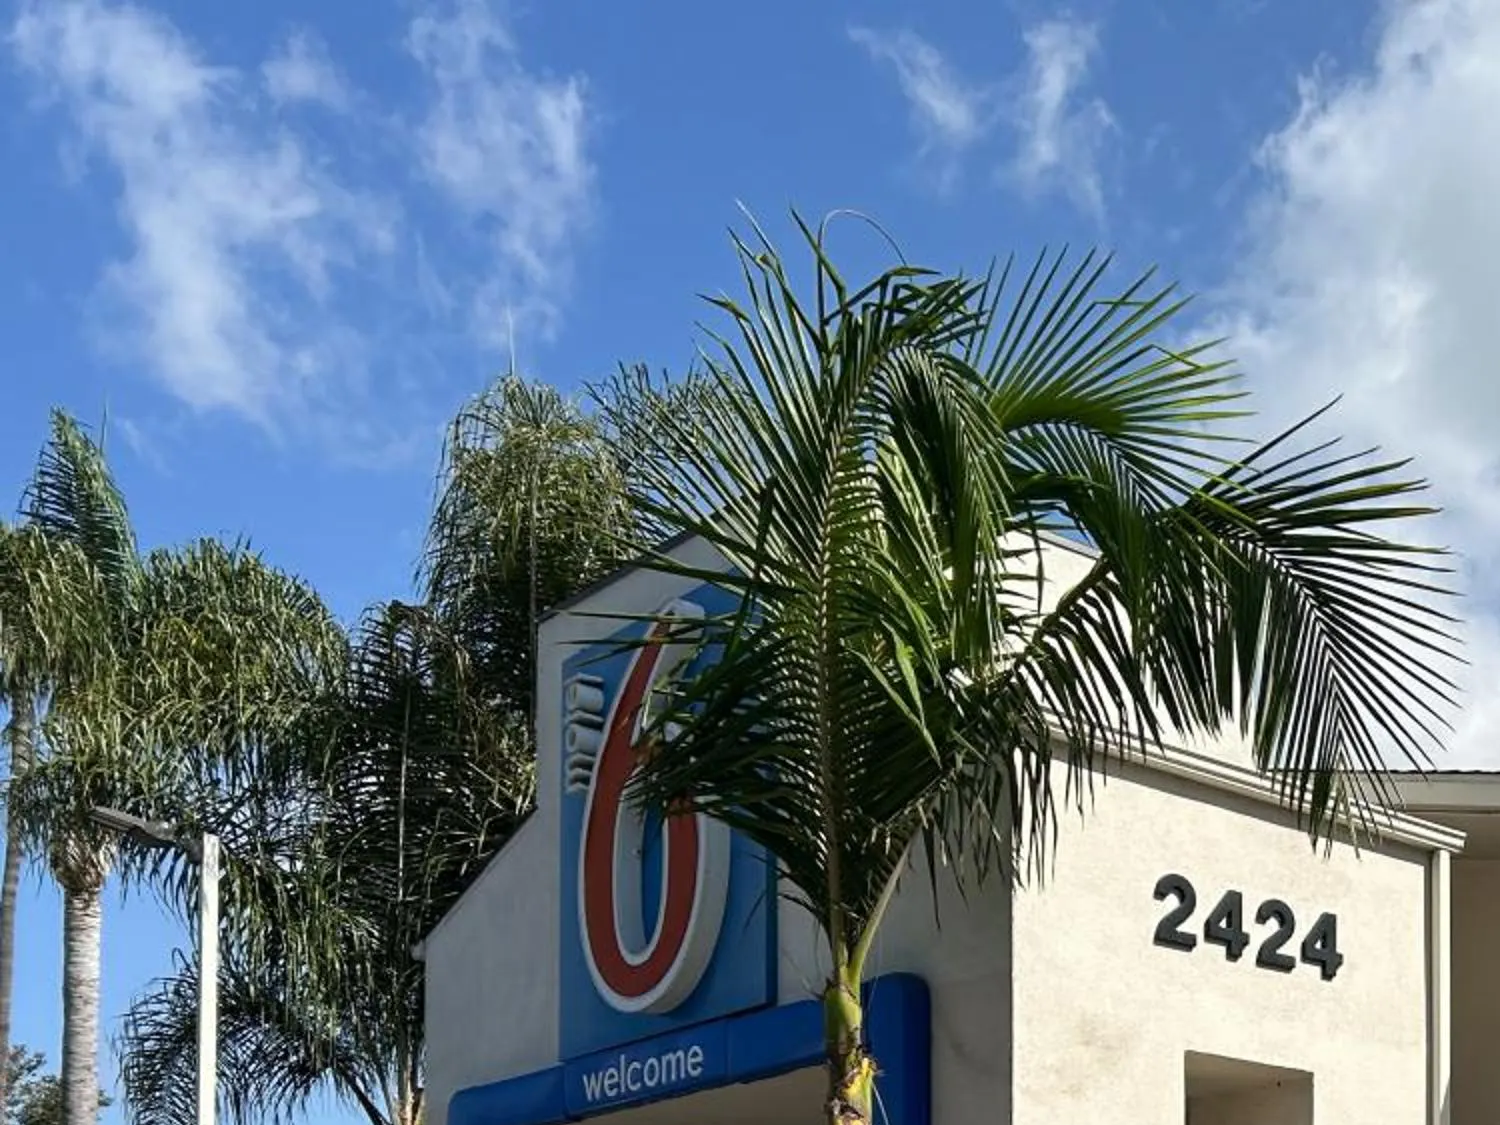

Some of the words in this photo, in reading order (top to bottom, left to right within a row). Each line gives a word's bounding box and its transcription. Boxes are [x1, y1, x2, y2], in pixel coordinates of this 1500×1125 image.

[579, 600, 730, 1014] 6
[1153, 873, 1344, 982] 2424
[583, 1045, 704, 1101] welcome
